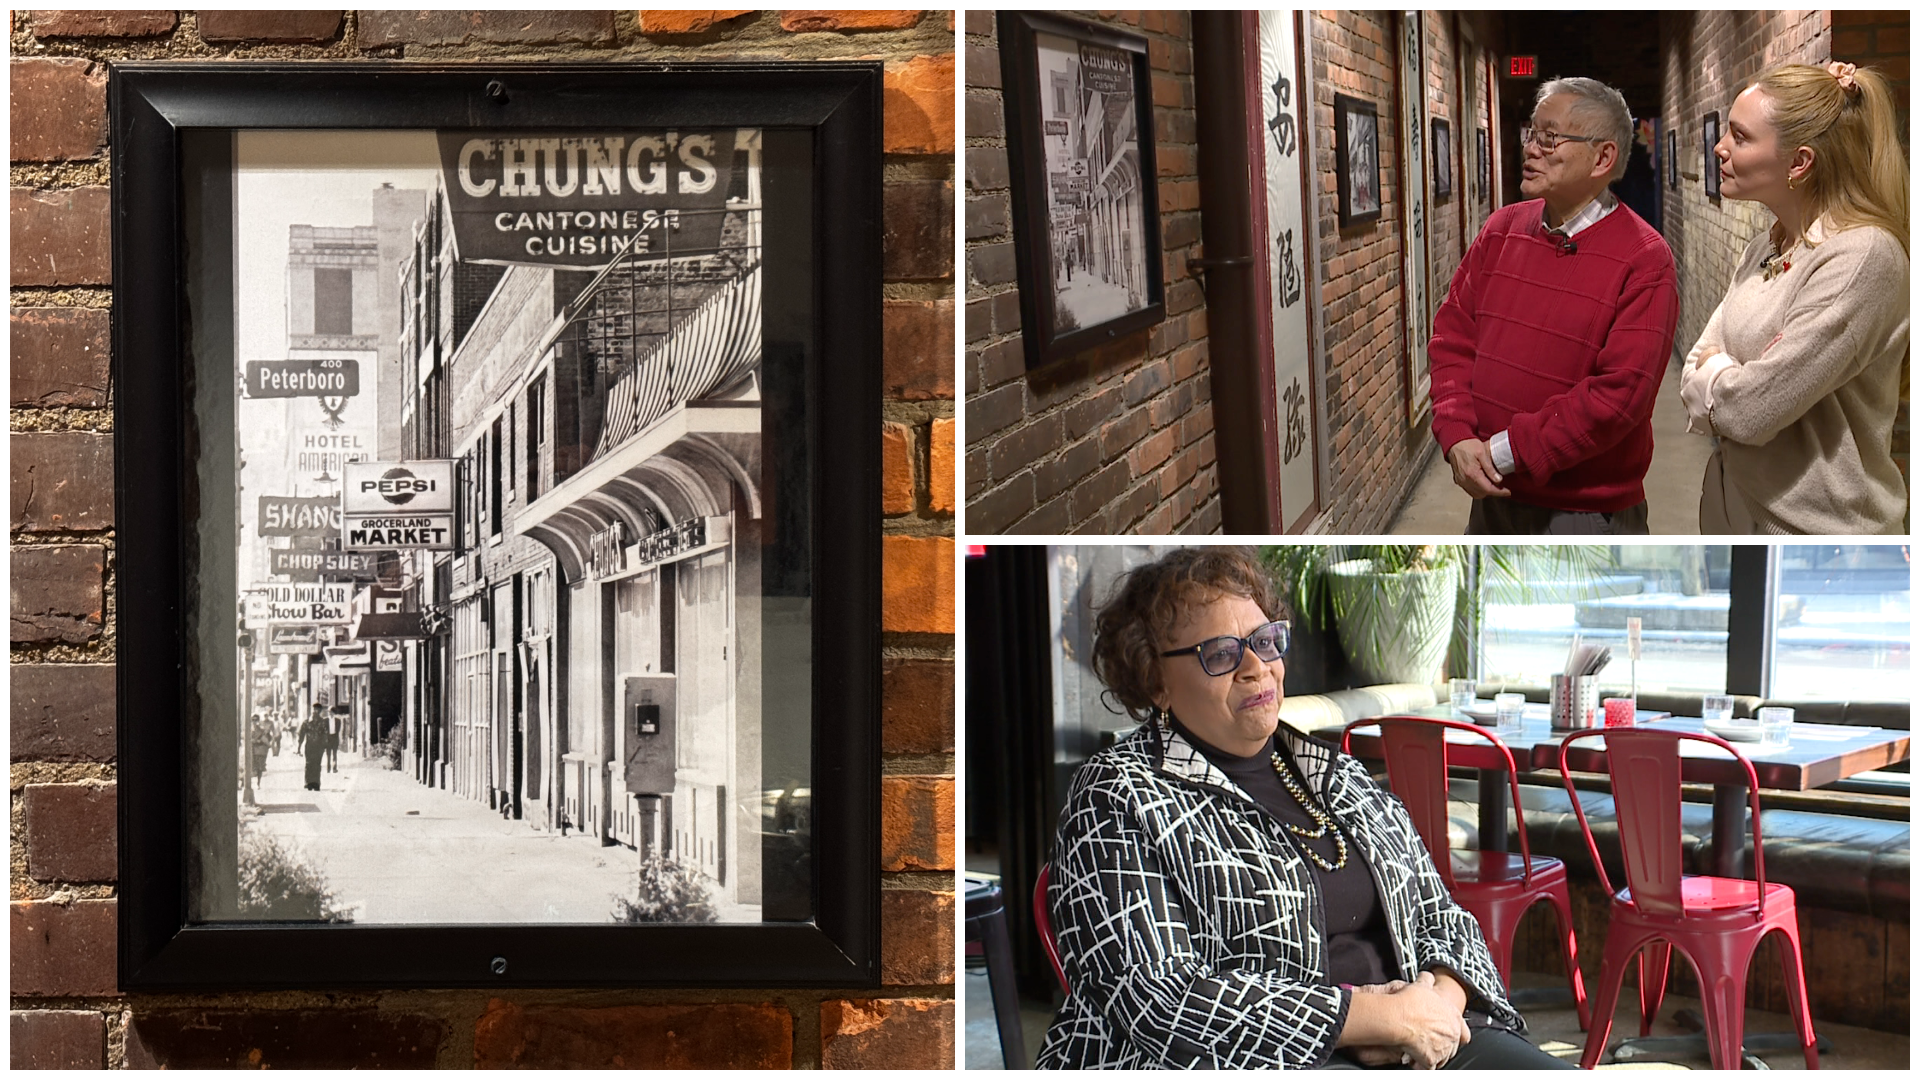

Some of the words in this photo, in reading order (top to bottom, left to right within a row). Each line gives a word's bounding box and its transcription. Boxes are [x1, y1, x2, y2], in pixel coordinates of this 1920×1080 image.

[1511, 56, 1534, 76] EXIT
[458, 132, 717, 198] CHUNG'S
[495, 209, 680, 231] CANTONESE
[525, 234, 650, 255] CUISINE
[320, 360, 342, 368] 400
[260, 367, 345, 390] Peterboro
[305, 435, 362, 448] HOTEL
[361, 479, 436, 493] PEPSI
[361, 518, 432, 529] GROCERLAND
[350, 528, 447, 546] MARKET
[277, 554, 323, 569] CHOP
[326, 555, 373, 570] SUEY
[262, 587, 290, 603] OLD
[294, 587, 345, 603] DOLLAR
[310, 603, 345, 620] Bar
